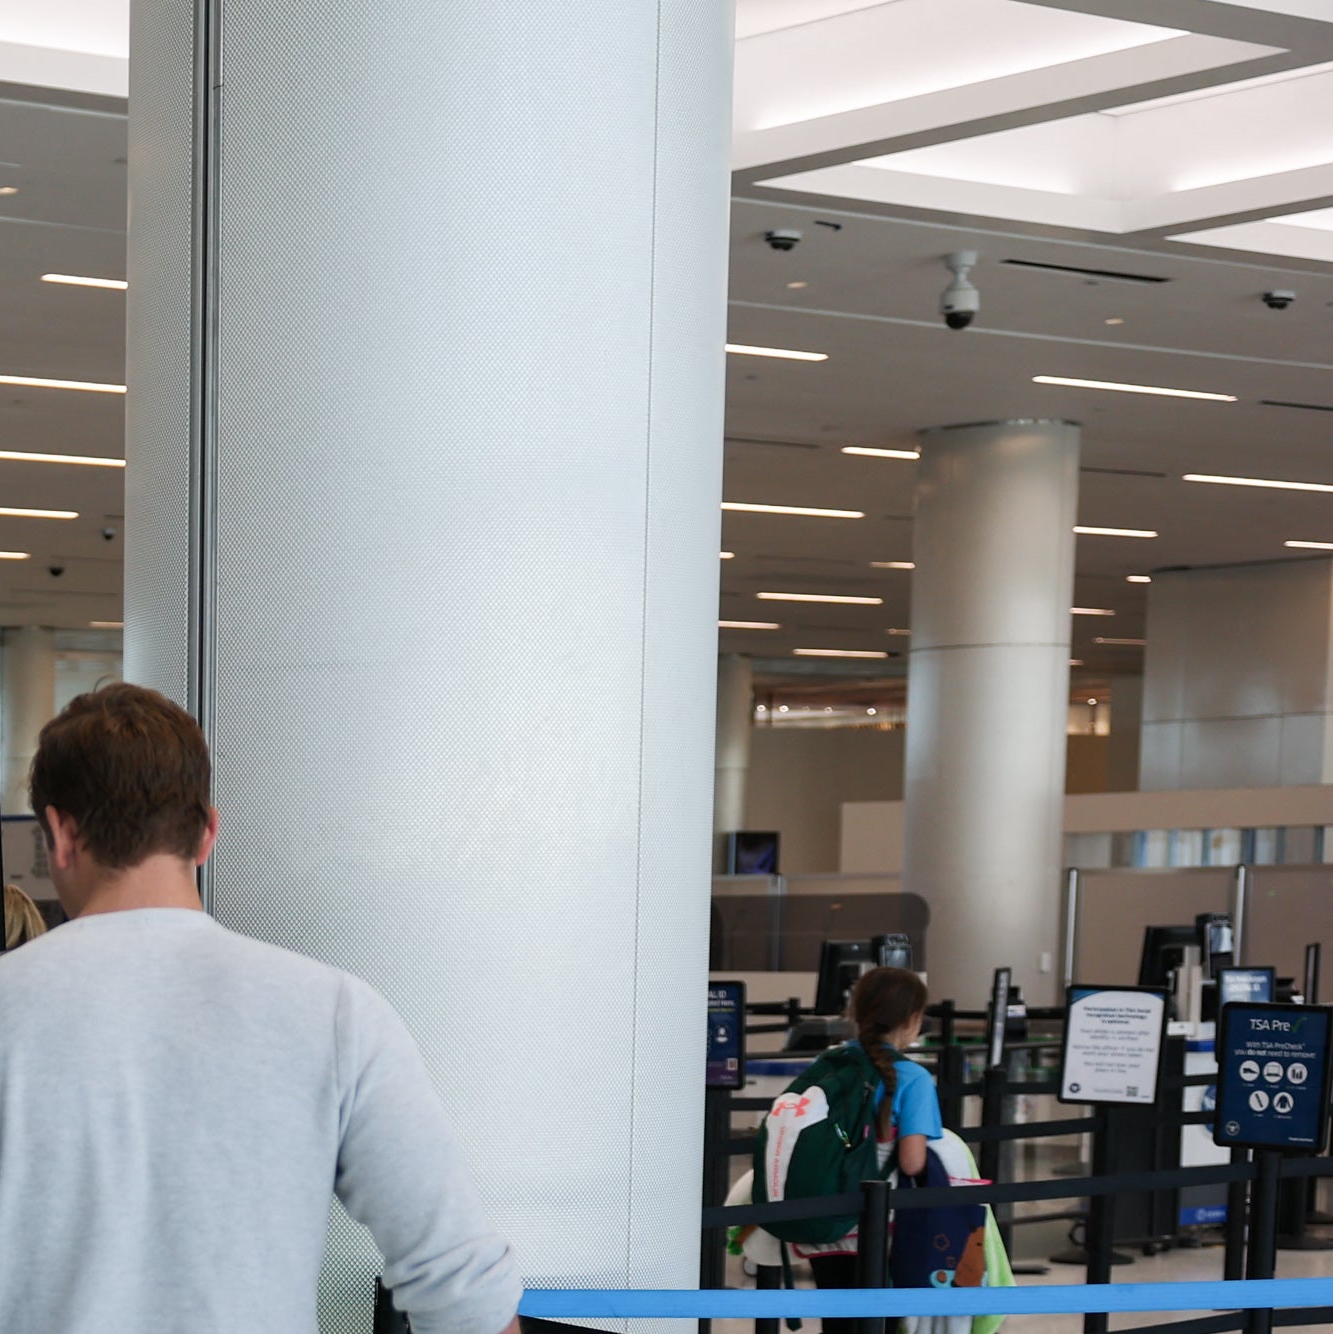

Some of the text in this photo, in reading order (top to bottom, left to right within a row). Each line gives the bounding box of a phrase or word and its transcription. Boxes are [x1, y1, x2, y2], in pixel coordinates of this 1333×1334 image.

[718, 990, 727, 998] ID
[1249, 1019, 1291, 1032] TSA Pre
